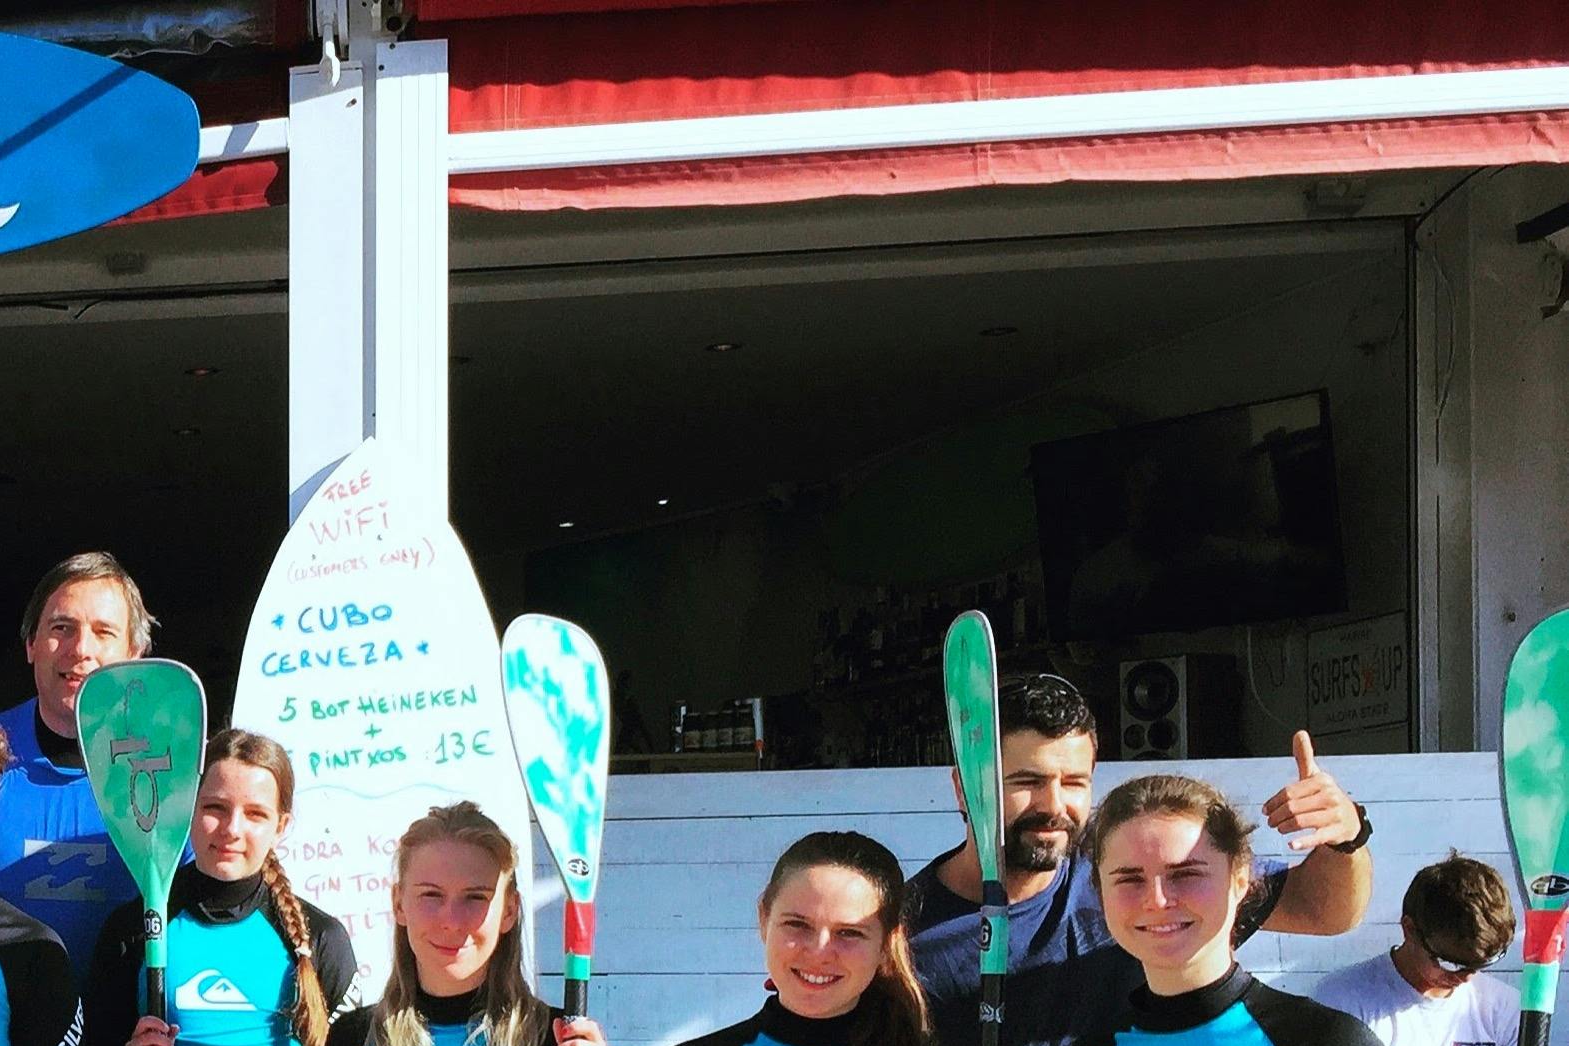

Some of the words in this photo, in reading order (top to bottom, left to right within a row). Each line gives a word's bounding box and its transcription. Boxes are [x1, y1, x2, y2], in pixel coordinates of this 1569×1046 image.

[322, 469, 372, 502] FREE
[297, 602, 394, 634] CUBO
[261, 640, 404, 678] CERVEZA
[278, 696, 298, 722] 5
